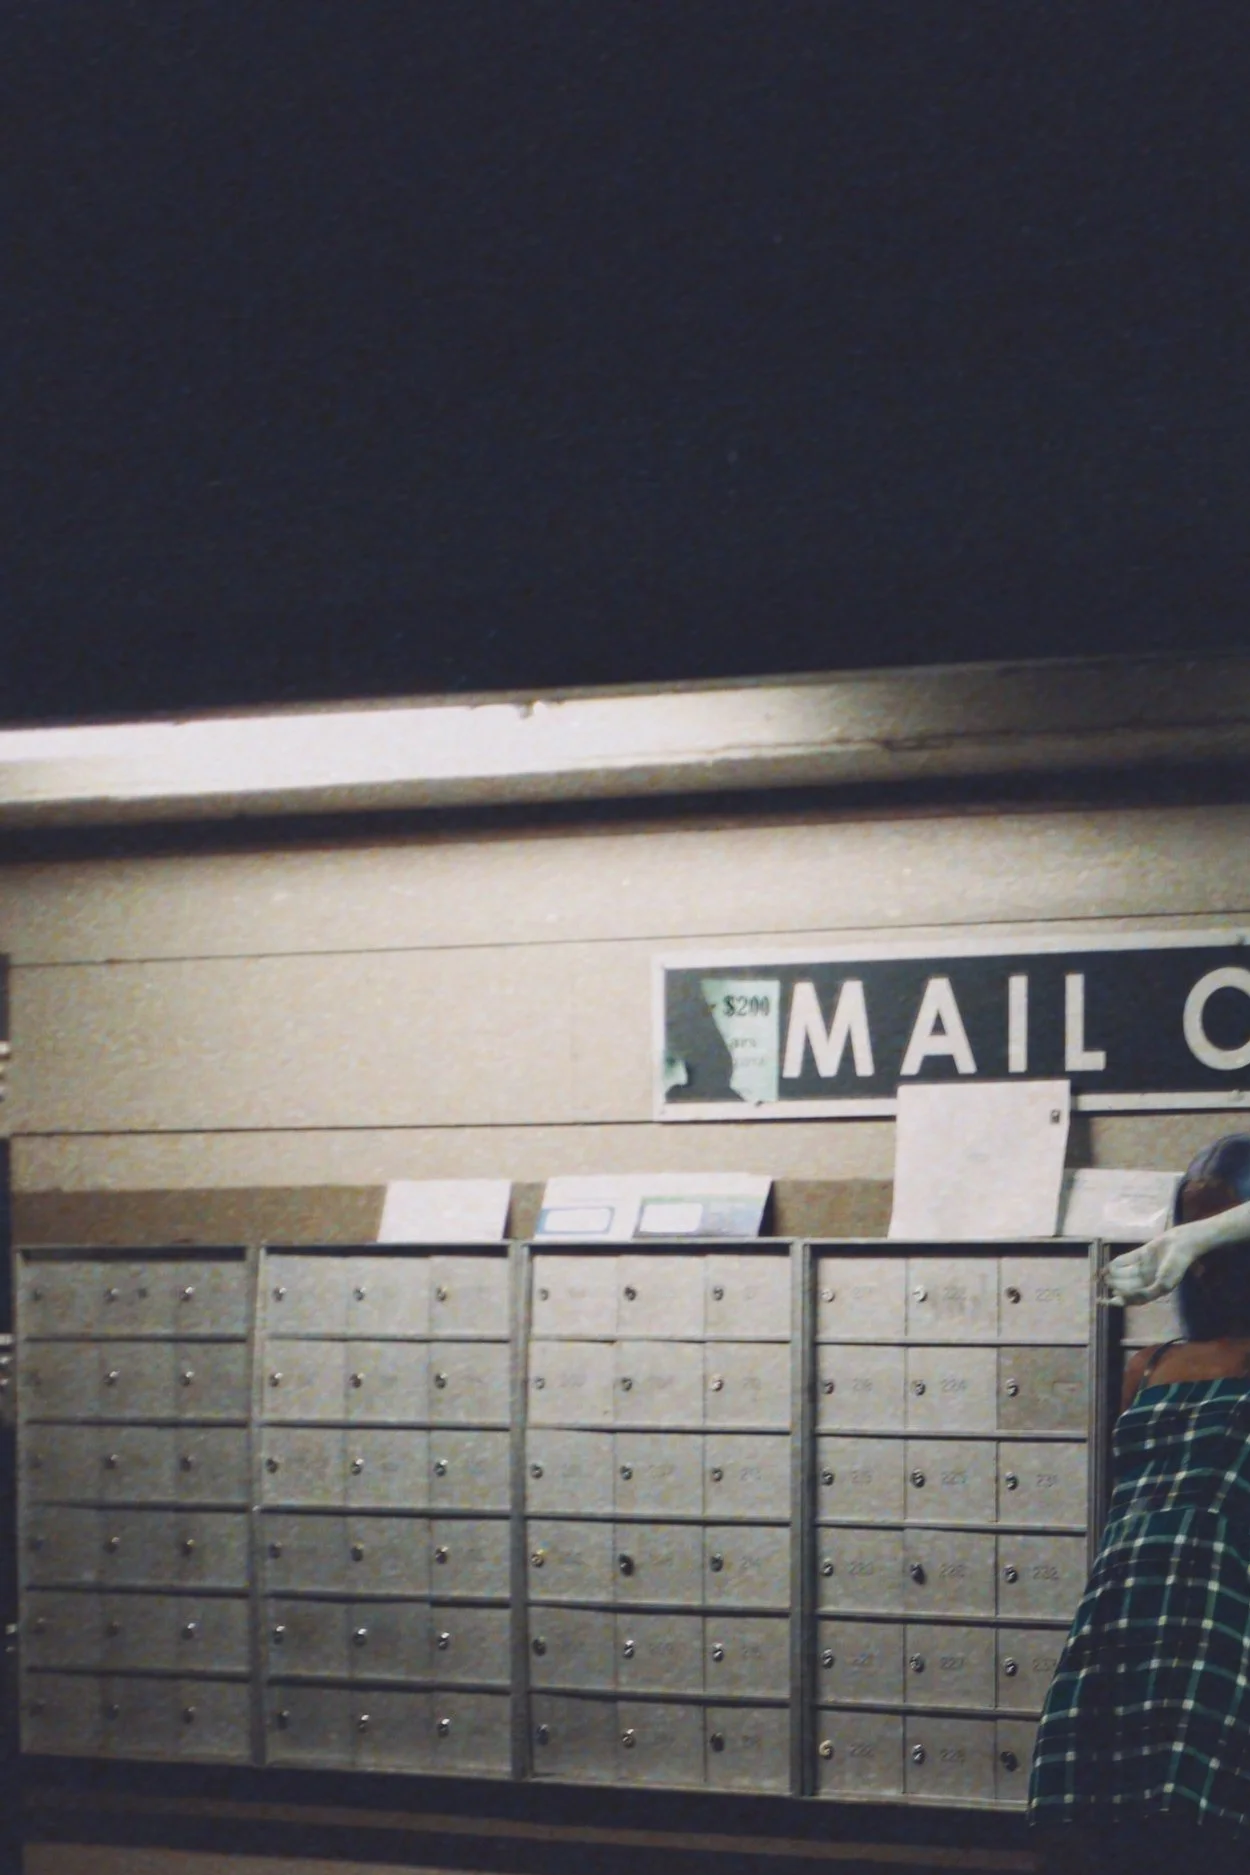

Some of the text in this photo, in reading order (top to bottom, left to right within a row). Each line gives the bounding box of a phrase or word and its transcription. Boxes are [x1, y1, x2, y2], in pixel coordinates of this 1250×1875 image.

[723, 995, 770, 1016] $200
[782, 973, 1107, 1078] MAIL
[1032, 1565, 1060, 1581] 232
